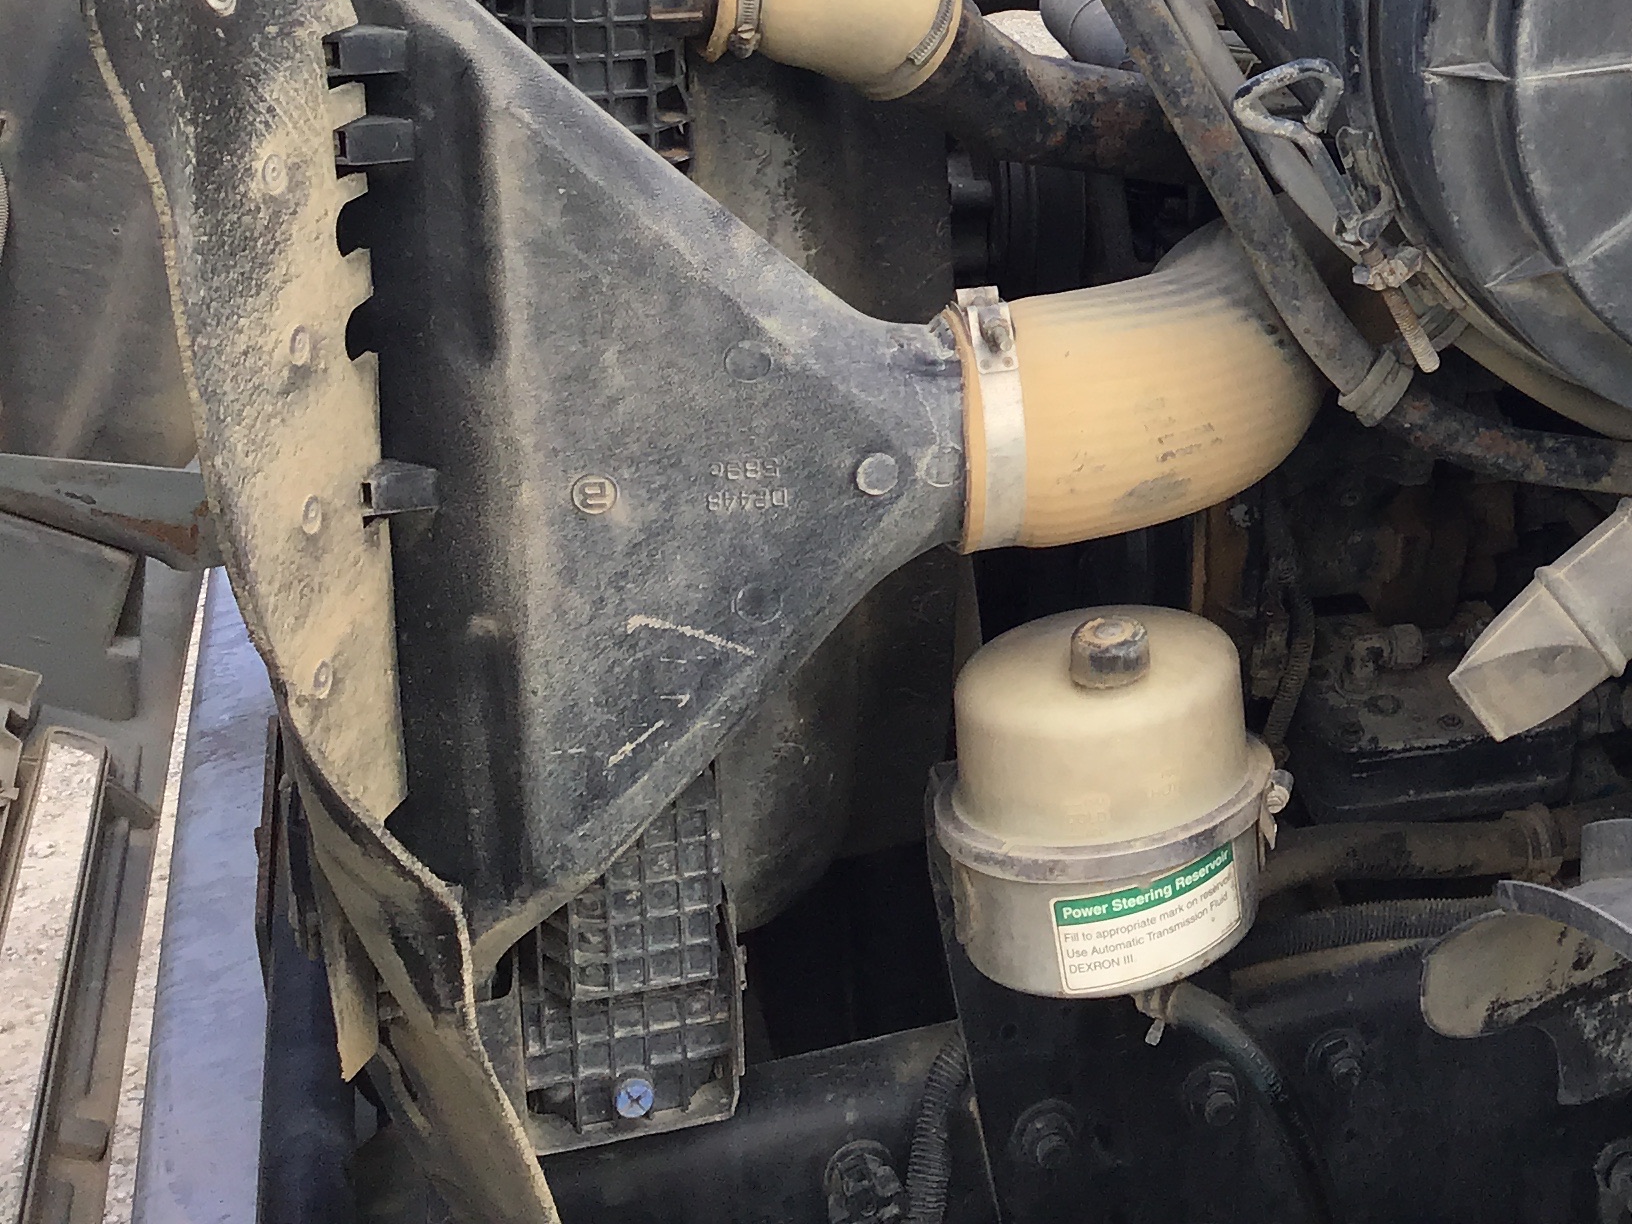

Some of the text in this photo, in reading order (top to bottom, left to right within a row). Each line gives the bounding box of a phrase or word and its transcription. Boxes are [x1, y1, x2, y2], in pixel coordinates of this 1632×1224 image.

[1062, 849, 1229, 919] Power Steering Reservoir
[1064, 932, 1079, 943] Fill
[1081, 932, 1093, 942] to
[1095, 916, 1157, 940] appropriate
[1159, 904, 1185, 921] mark
[1186, 897, 1198, 909] on
[1066, 948, 1088, 959] Use
[1091, 936, 1145, 956] Automatic
[1146, 907, 1208, 942] Transmission
[1209, 890, 1229, 912] Fluid
[1069, 957, 1120, 975] DEXRON
